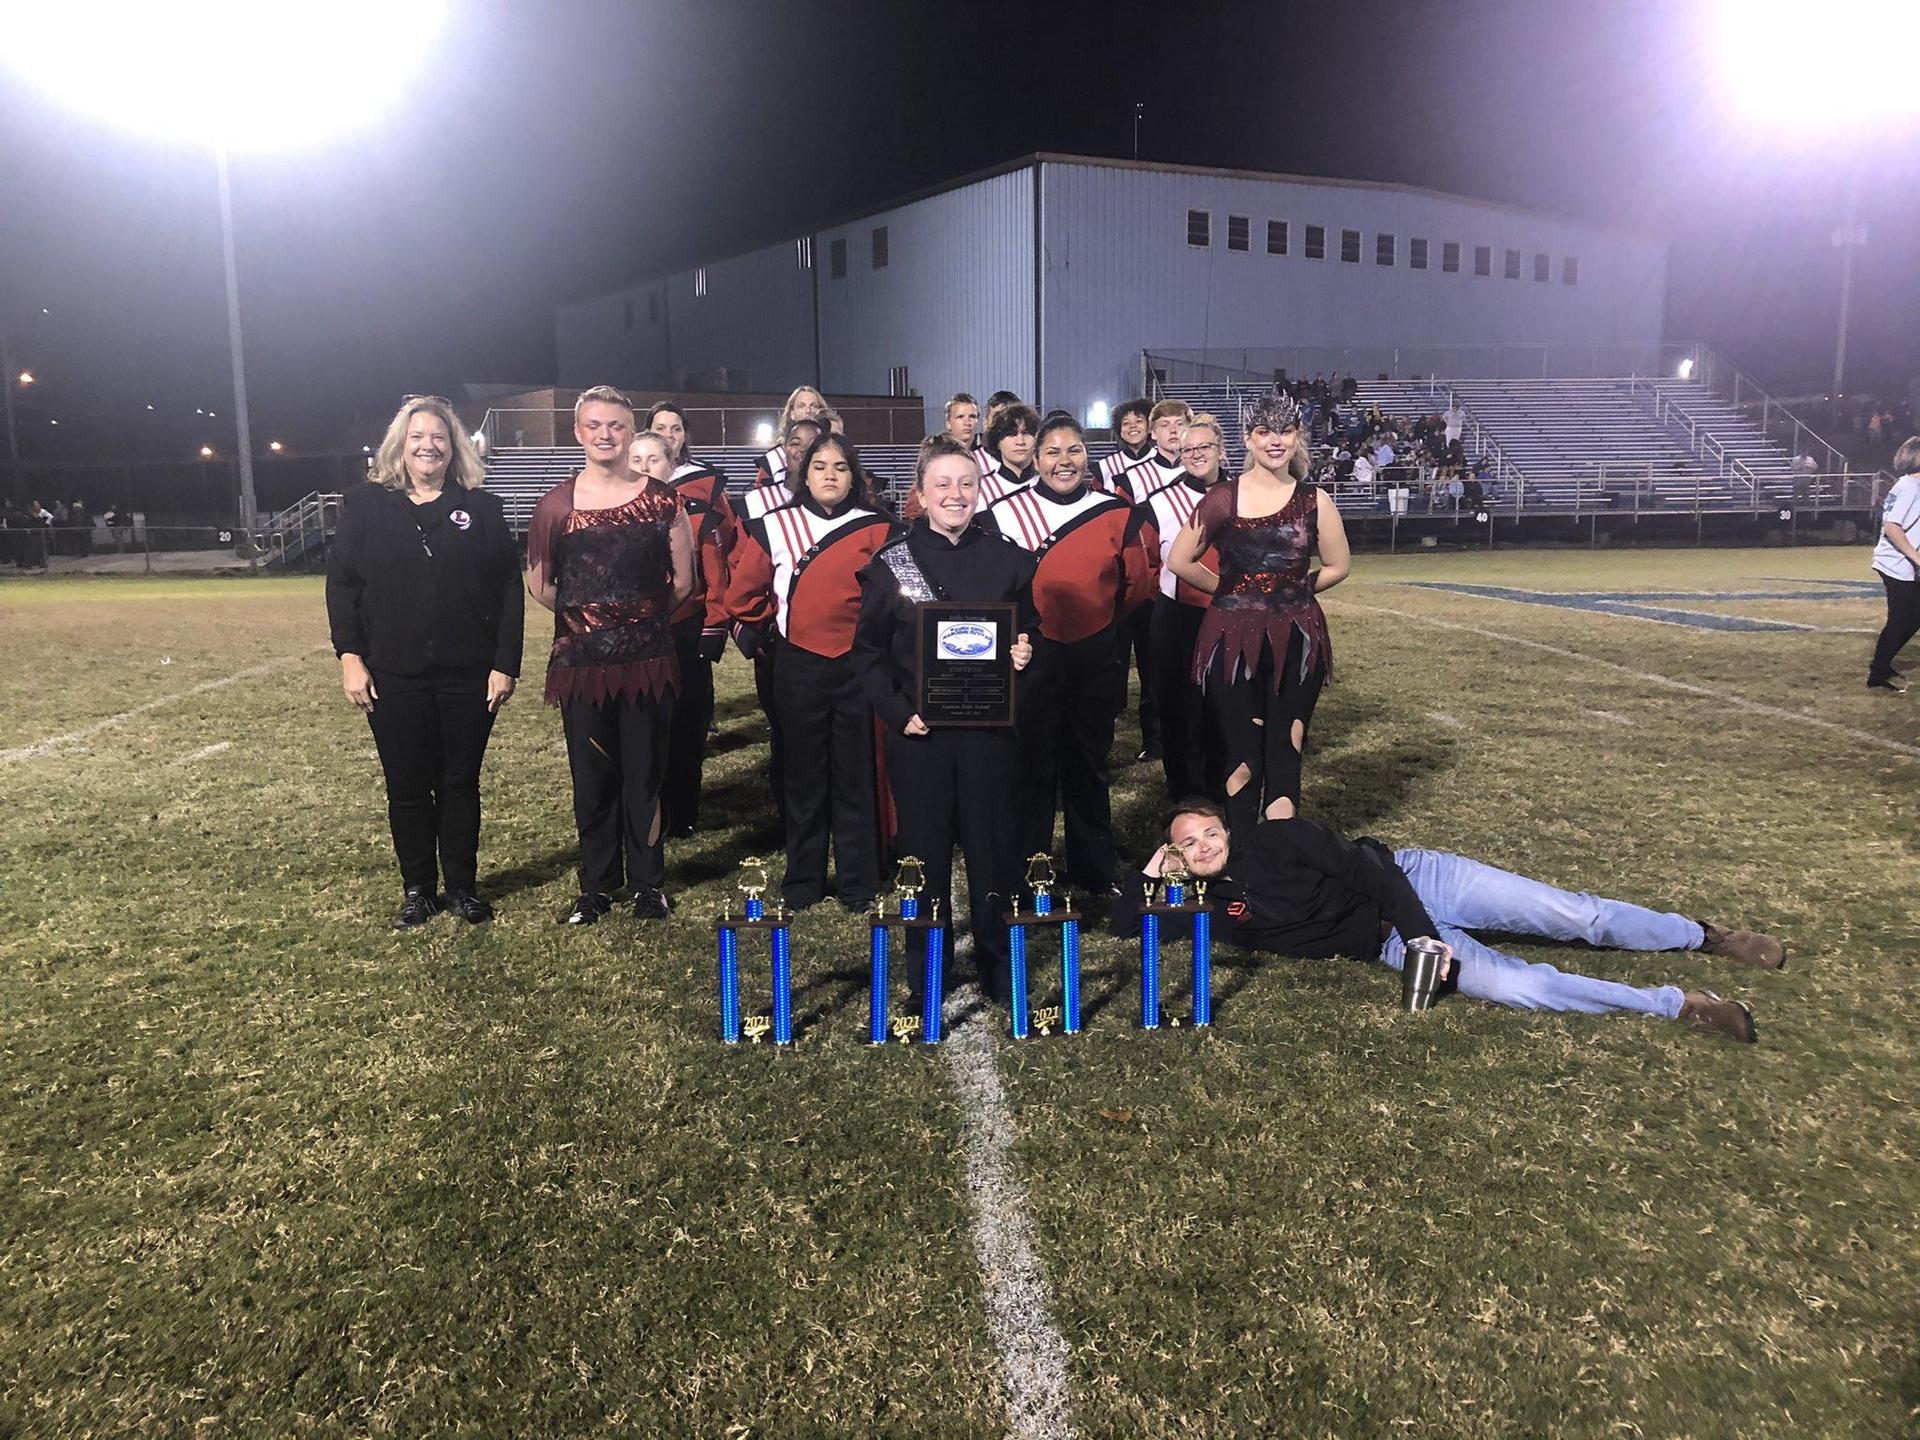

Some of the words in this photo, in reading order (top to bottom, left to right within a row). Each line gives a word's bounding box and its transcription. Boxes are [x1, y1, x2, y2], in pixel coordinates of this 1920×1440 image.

[455, 512, 467, 522] L
[1476, 512, 1488, 522] 40
[1779, 510, 1791, 520] 30
[219, 531, 232, 542] 20
[1033, 1005, 1059, 1023] 2021
[744, 1016, 770, 1030] 2021
[893, 1016, 920, 1030] 2021
